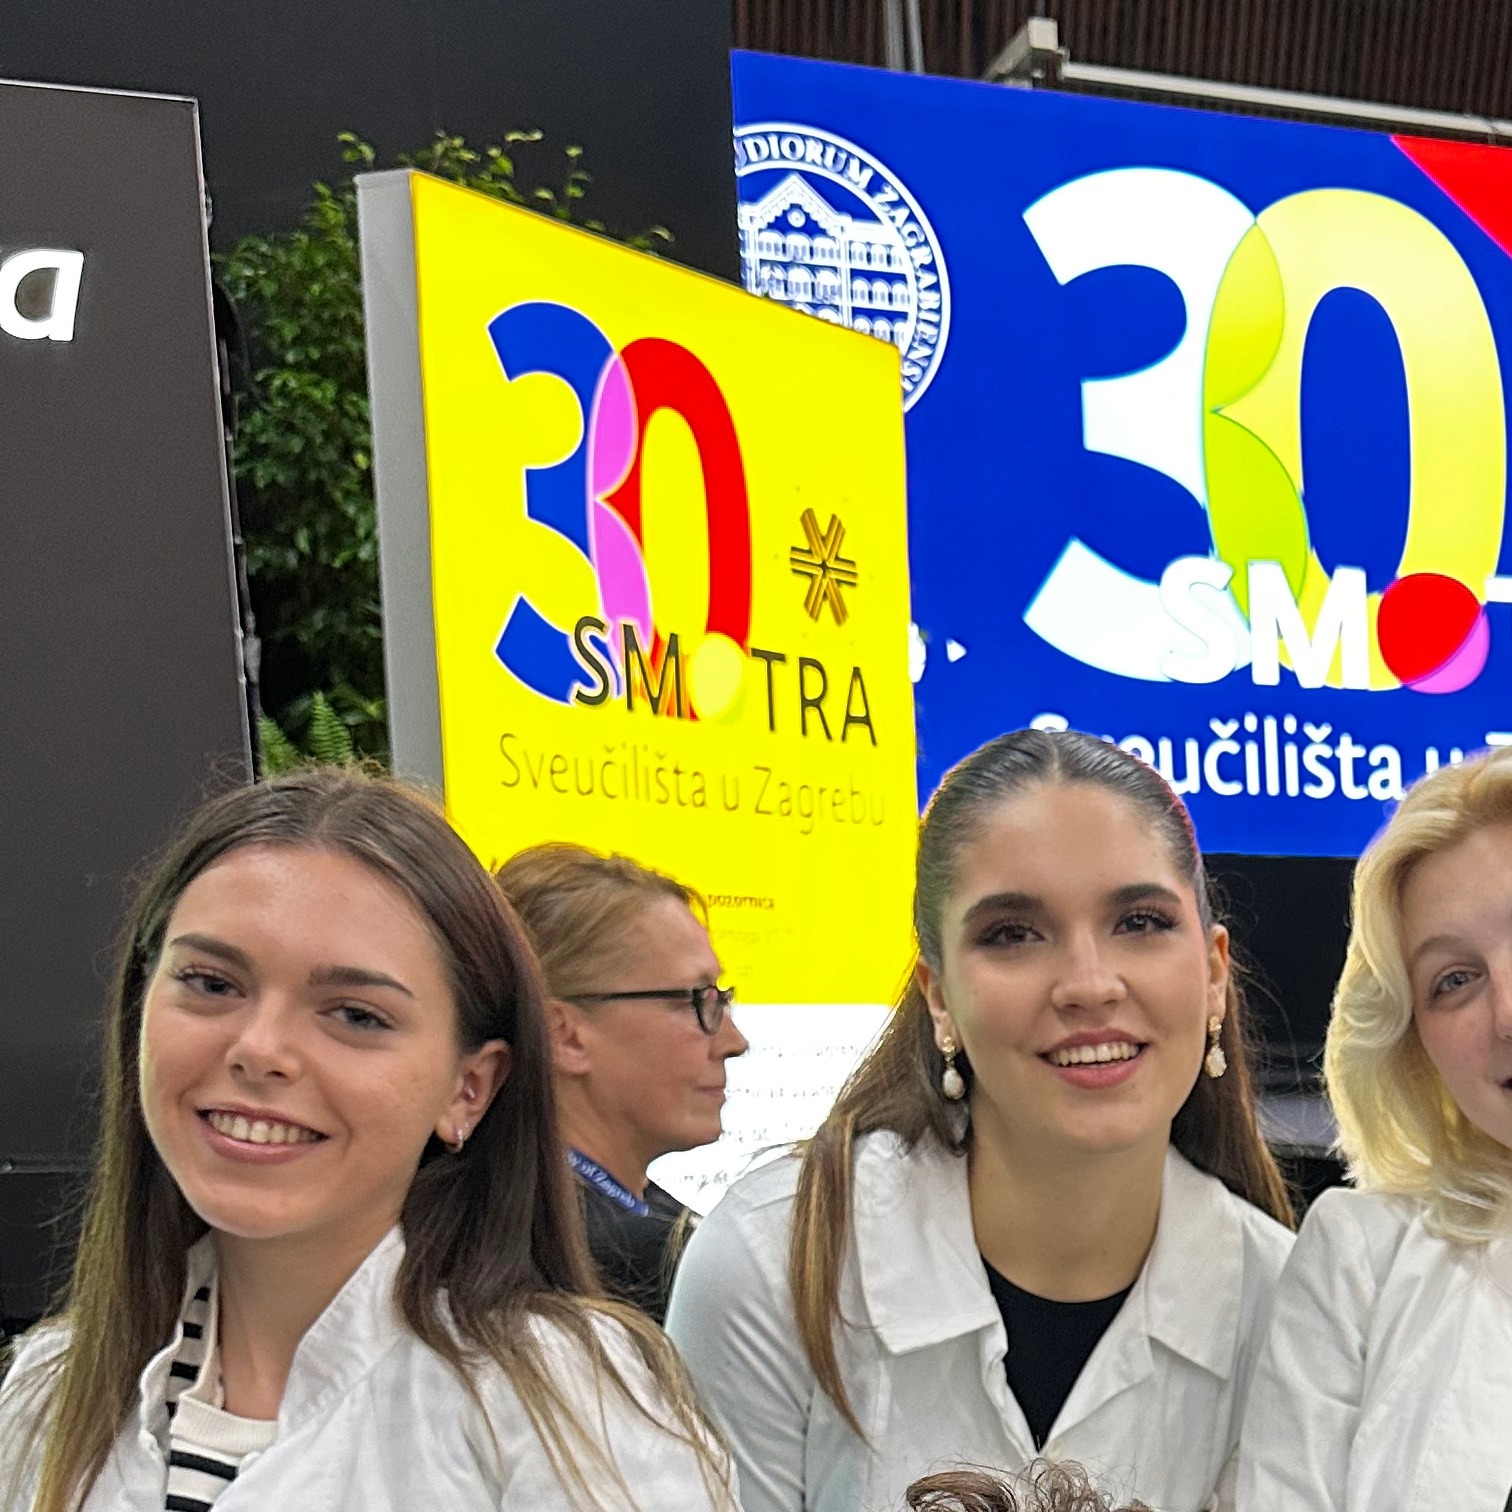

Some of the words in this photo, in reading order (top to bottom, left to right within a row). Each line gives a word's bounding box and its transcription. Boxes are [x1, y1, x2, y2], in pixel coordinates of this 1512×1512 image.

[486, 300, 753, 722] 30
[1023, 167, 1508, 693] 30
[499, 732, 708, 810] Sveučilišta
[721, 773, 741, 812] u
[753, 764, 887, 836] Zagrebu
[571, 615, 878, 748] SMOTRA
